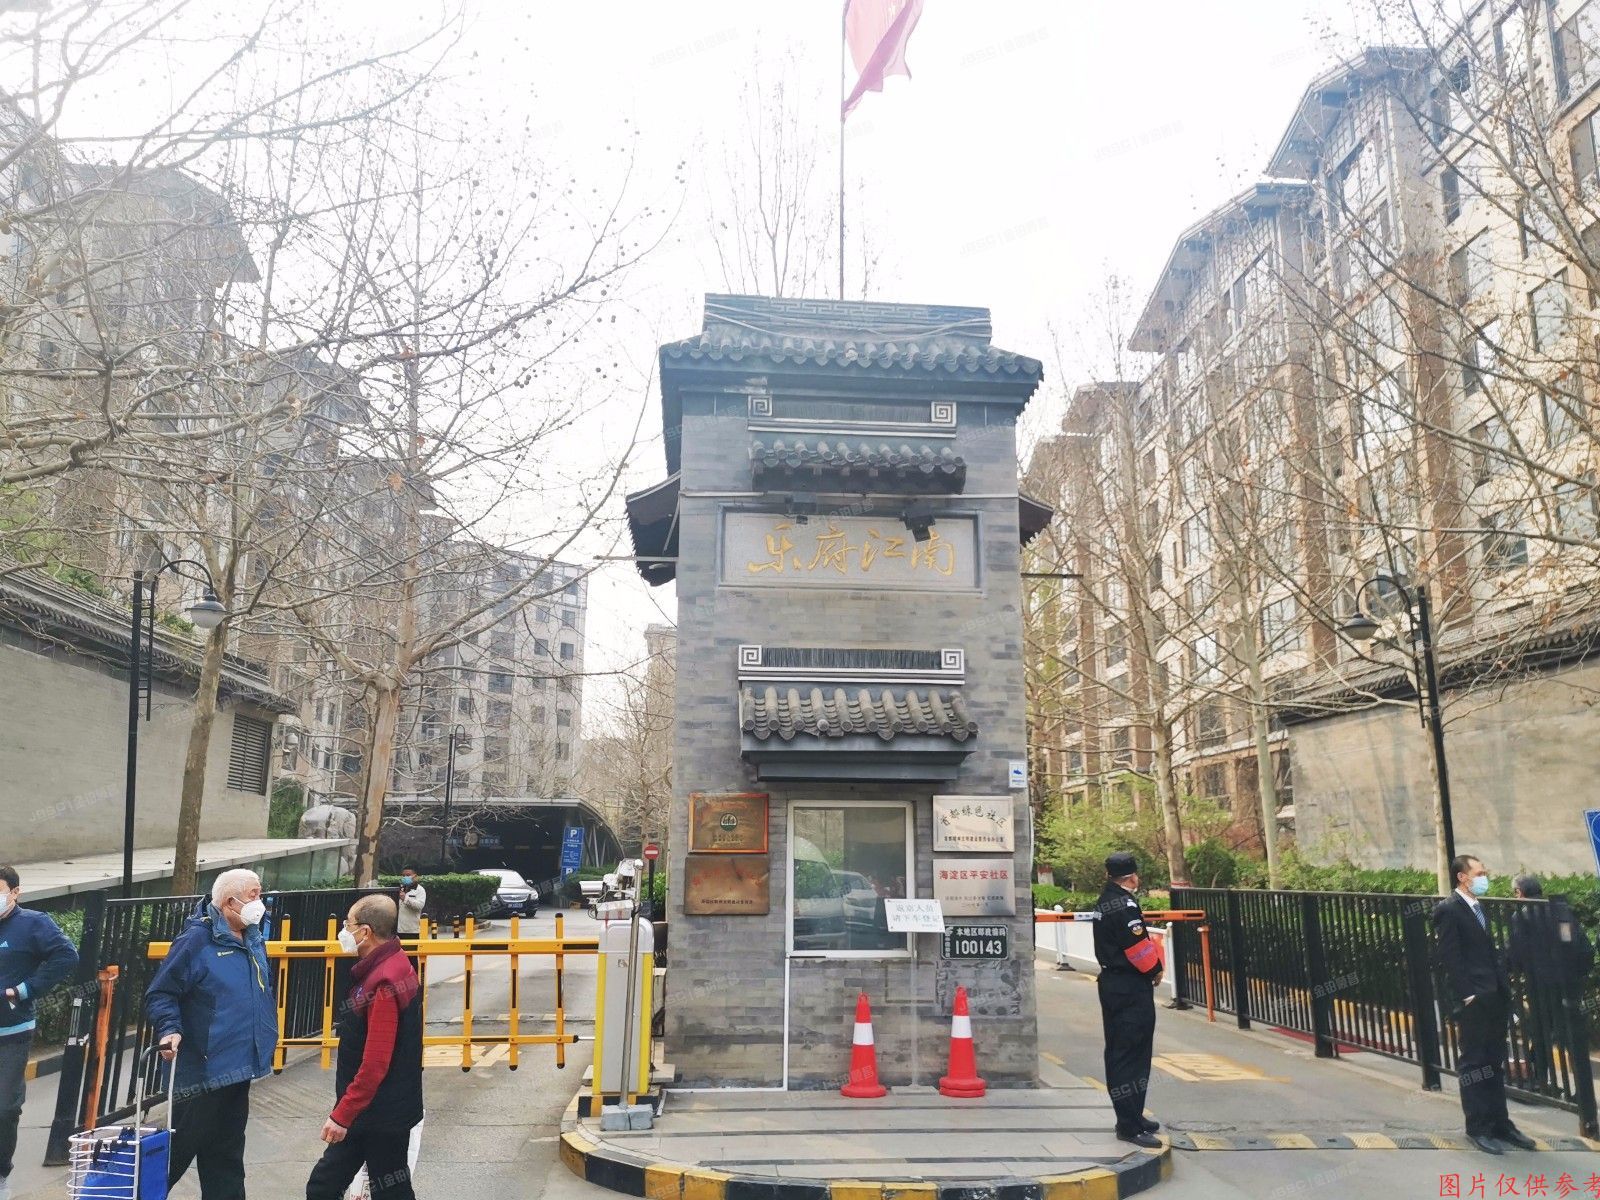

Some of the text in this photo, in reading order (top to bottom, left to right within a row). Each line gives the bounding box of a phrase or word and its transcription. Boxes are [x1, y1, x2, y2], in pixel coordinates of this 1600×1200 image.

[747, 523, 956, 576] 乐府江南
[939, 869, 1009, 880] 海淀区平安社区
[956, 927, 1006, 937] 本地区邮政编码
[955, 940, 1003, 955] 100143
